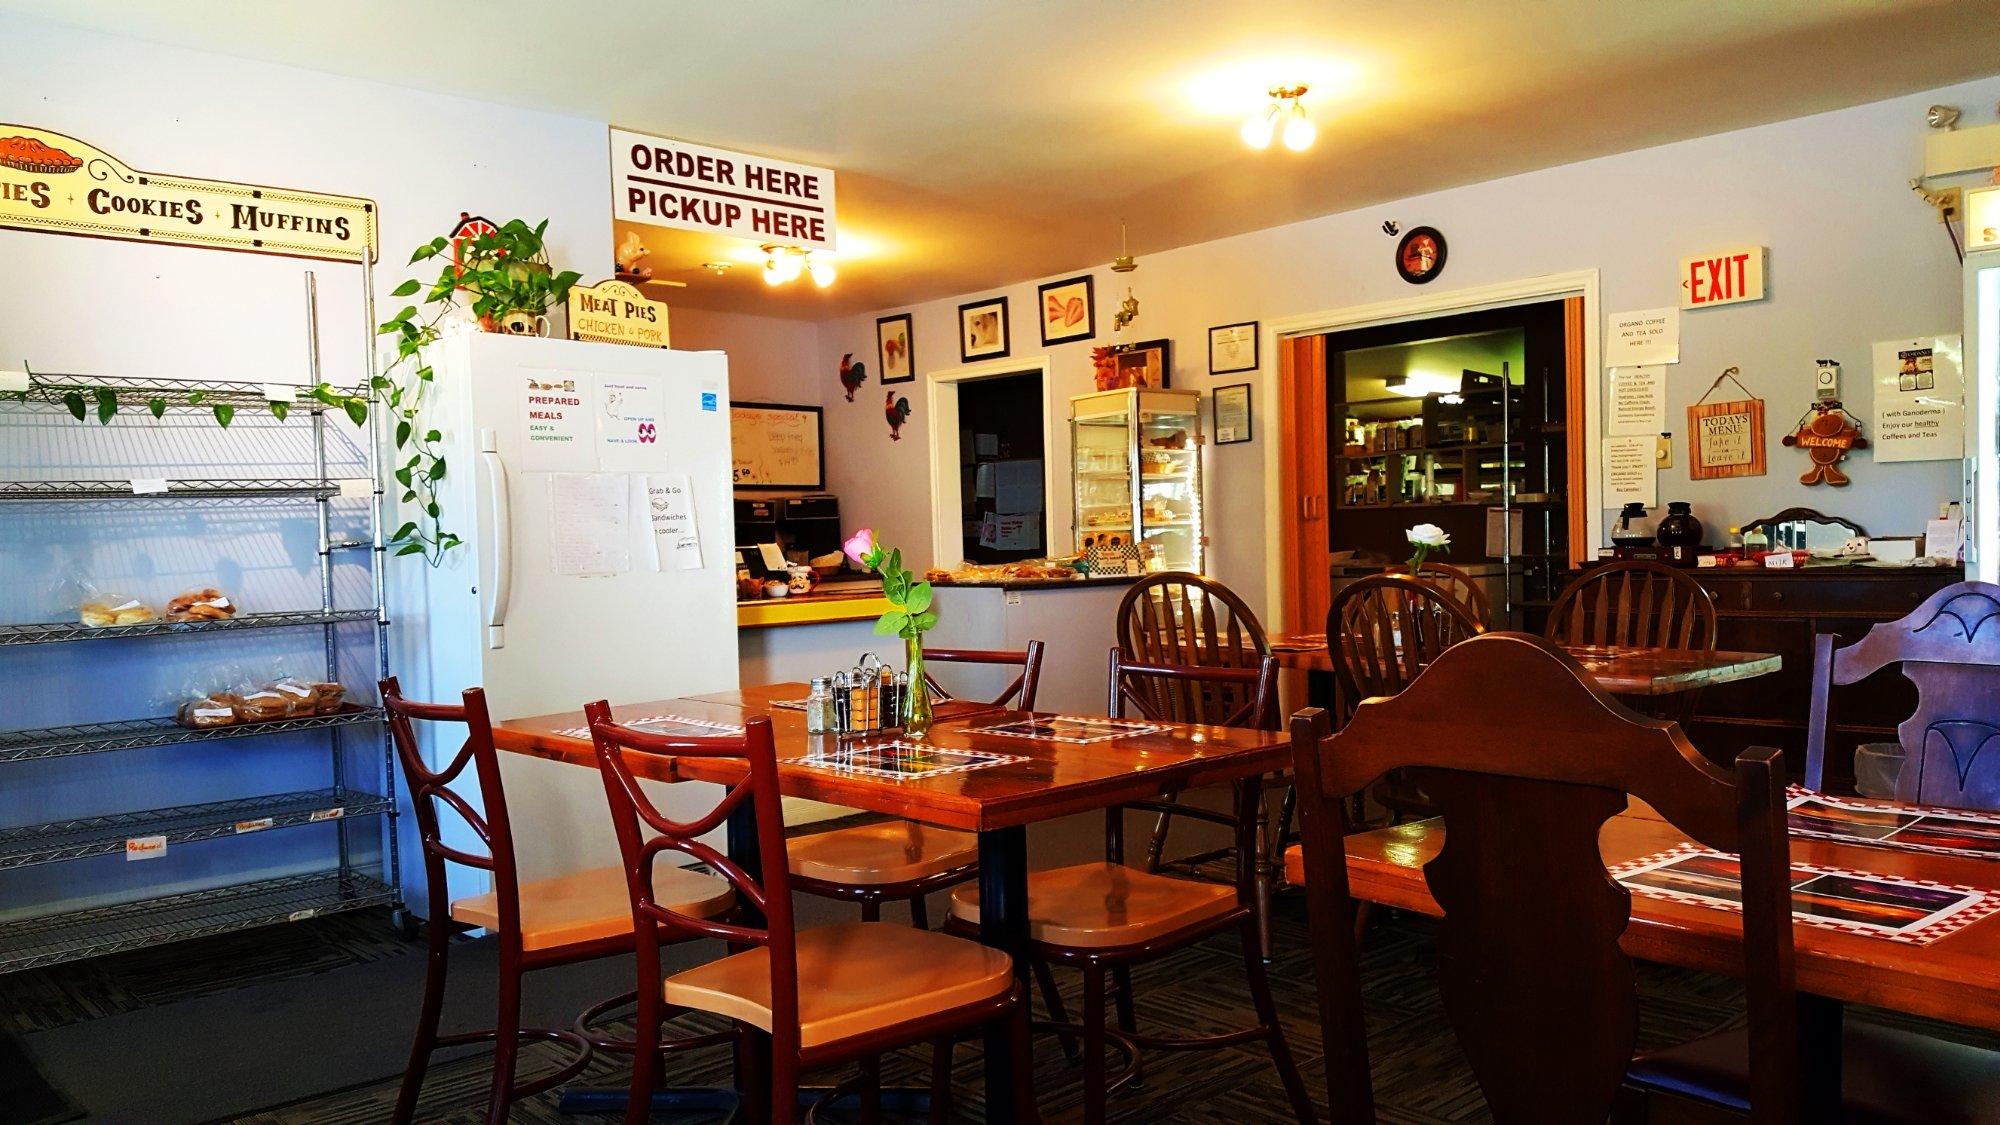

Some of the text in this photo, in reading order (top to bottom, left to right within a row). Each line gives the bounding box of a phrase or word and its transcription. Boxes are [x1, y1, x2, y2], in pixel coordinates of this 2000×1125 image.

[630, 144, 820, 201] ORDER HERE
[0, 181, 51, 209] IES
[628, 186, 827, 243] PICKUP HERE
[1690, 253, 1750, 305] EXIT
[580, 293, 657, 323] MEAT PIES
[1645, 317, 1666, 326] COFFEE
[577, 318, 625, 336] CHICKEN
[637, 327, 664, 343] PORK
[528, 396, 580, 406] PREPARED
[529, 411, 563, 420] MEALS
[1886, 410, 1901, 418] with
[1902, 408, 1941, 418] Ganoderma
[1703, 414, 1748, 427] TODAYS
[1882, 422, 1900, 430] Enjoy
[1914, 419, 1940, 429] healthy
[1881, 432, 1907, 441] Coffees
[1801, 437, 1848, 449] WELCOME
[649, 487, 664, 495] Grab
[672, 486, 682, 494] Go
[651, 513, 688, 522] Sandwiches
